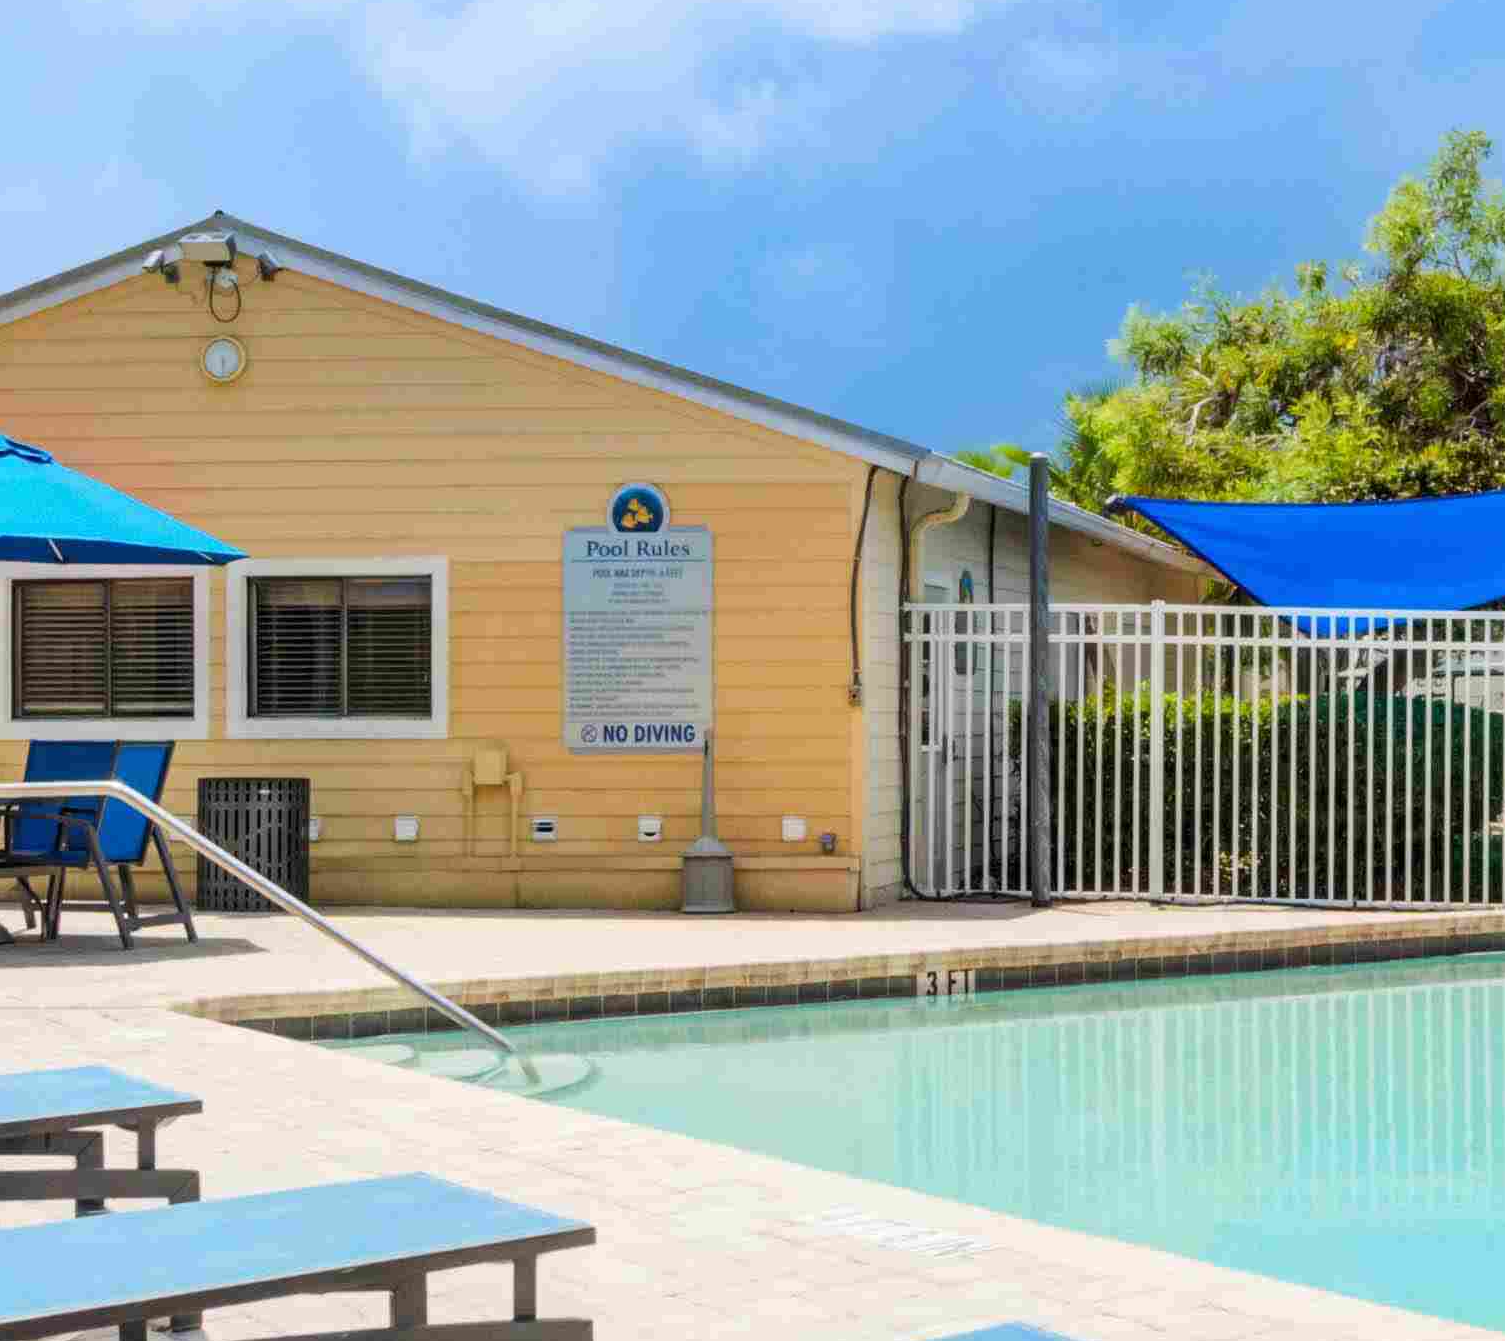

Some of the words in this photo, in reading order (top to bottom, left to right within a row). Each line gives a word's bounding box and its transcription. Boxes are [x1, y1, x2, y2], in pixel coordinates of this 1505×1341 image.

[587, 539, 628, 557] Pool
[637, 539, 690, 557] Rules
[604, 724, 628, 742] NO
[635, 724, 695, 742] DIVING
[926, 970, 938, 996] 3
[948, 969, 972, 996] FT
